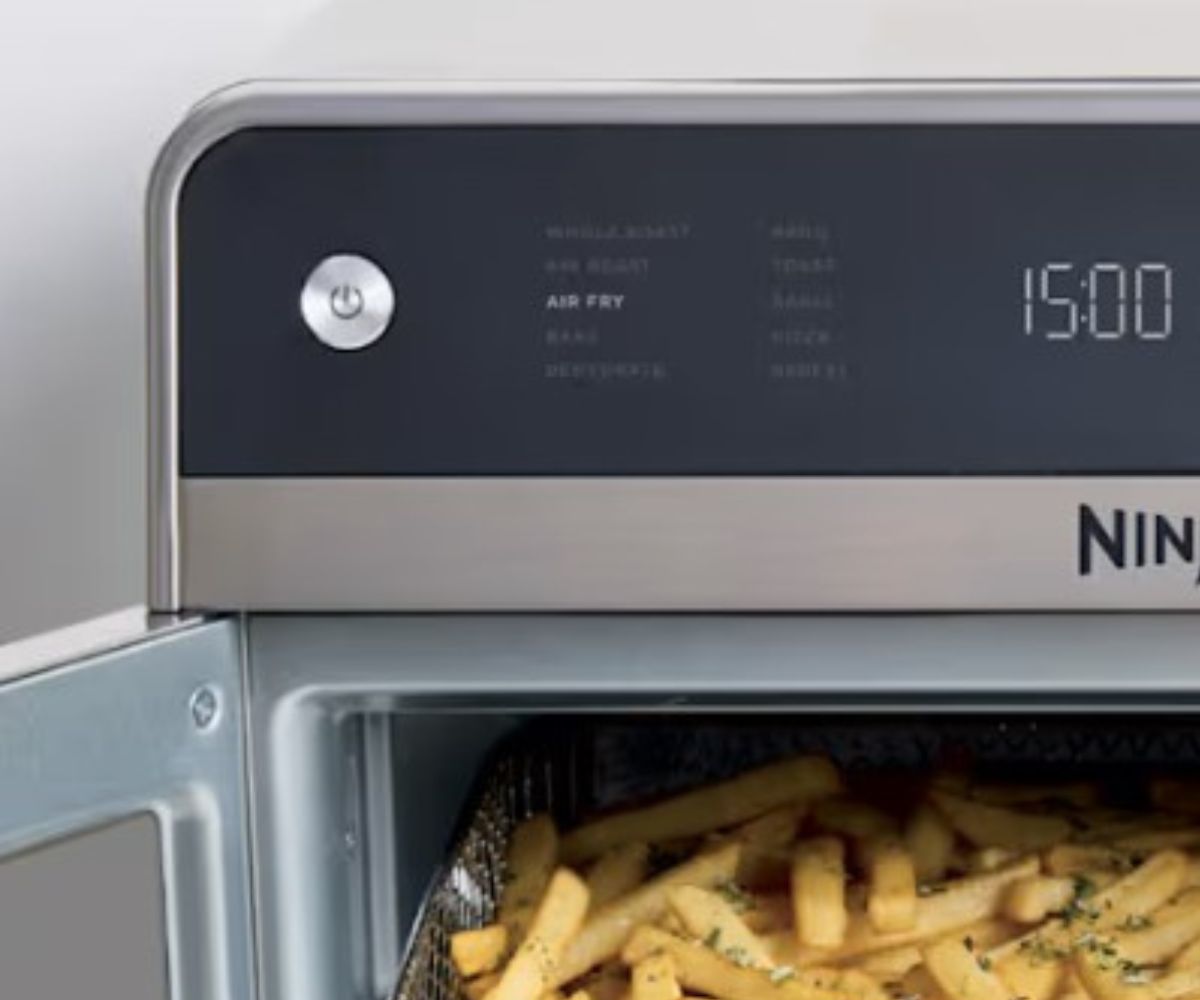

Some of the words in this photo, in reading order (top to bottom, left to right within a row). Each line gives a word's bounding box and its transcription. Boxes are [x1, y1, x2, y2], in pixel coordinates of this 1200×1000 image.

[547, 294, 580, 309] AIR
[586, 294, 624, 309] FRY
[1023, 263, 1172, 340] 15:00
